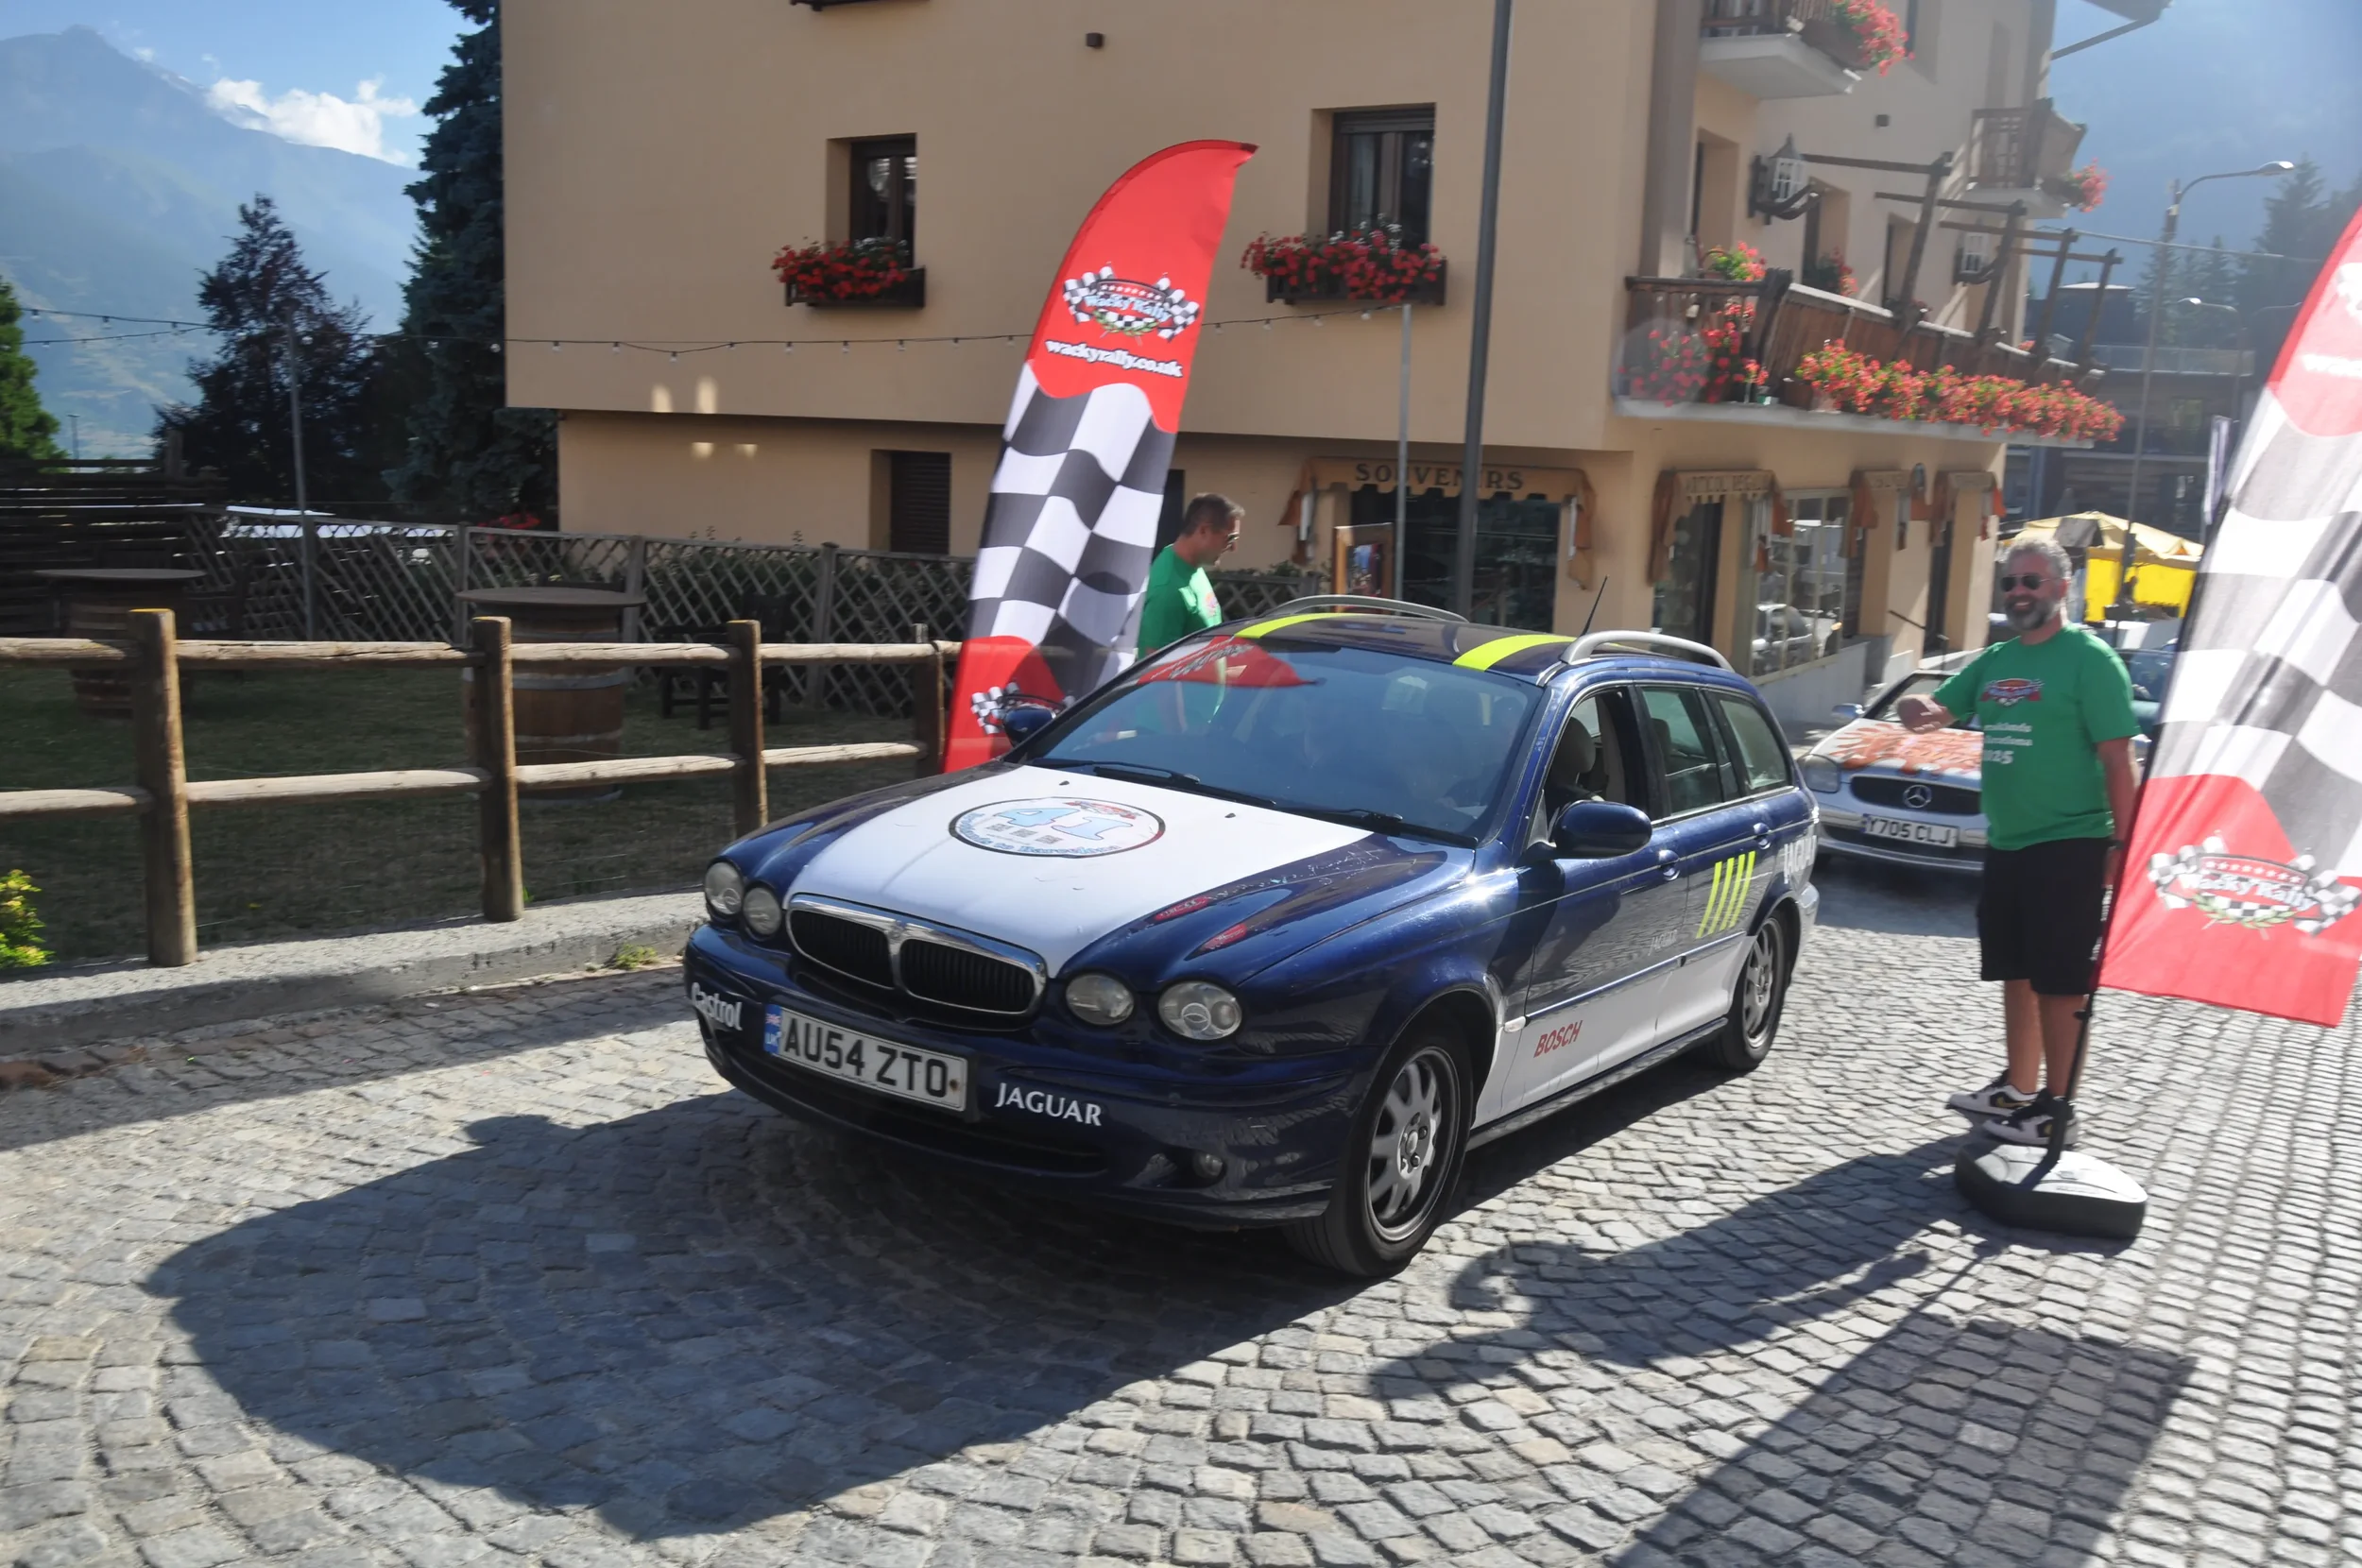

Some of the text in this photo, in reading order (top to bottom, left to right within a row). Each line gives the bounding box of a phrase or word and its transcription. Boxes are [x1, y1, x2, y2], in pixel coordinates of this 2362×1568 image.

[1044, 338, 1184, 378] wackyrally.co.uk
[1355, 462, 1524, 491] SOVENRS
[1869, 817, 1952, 844] Y705 CLJ
[691, 981, 744, 1031] Castrol
[783, 1017, 866, 1075] AU54
[1532, 1019, 1583, 1059] BOSCH
[995, 1082, 1103, 1127] JAGUAR
